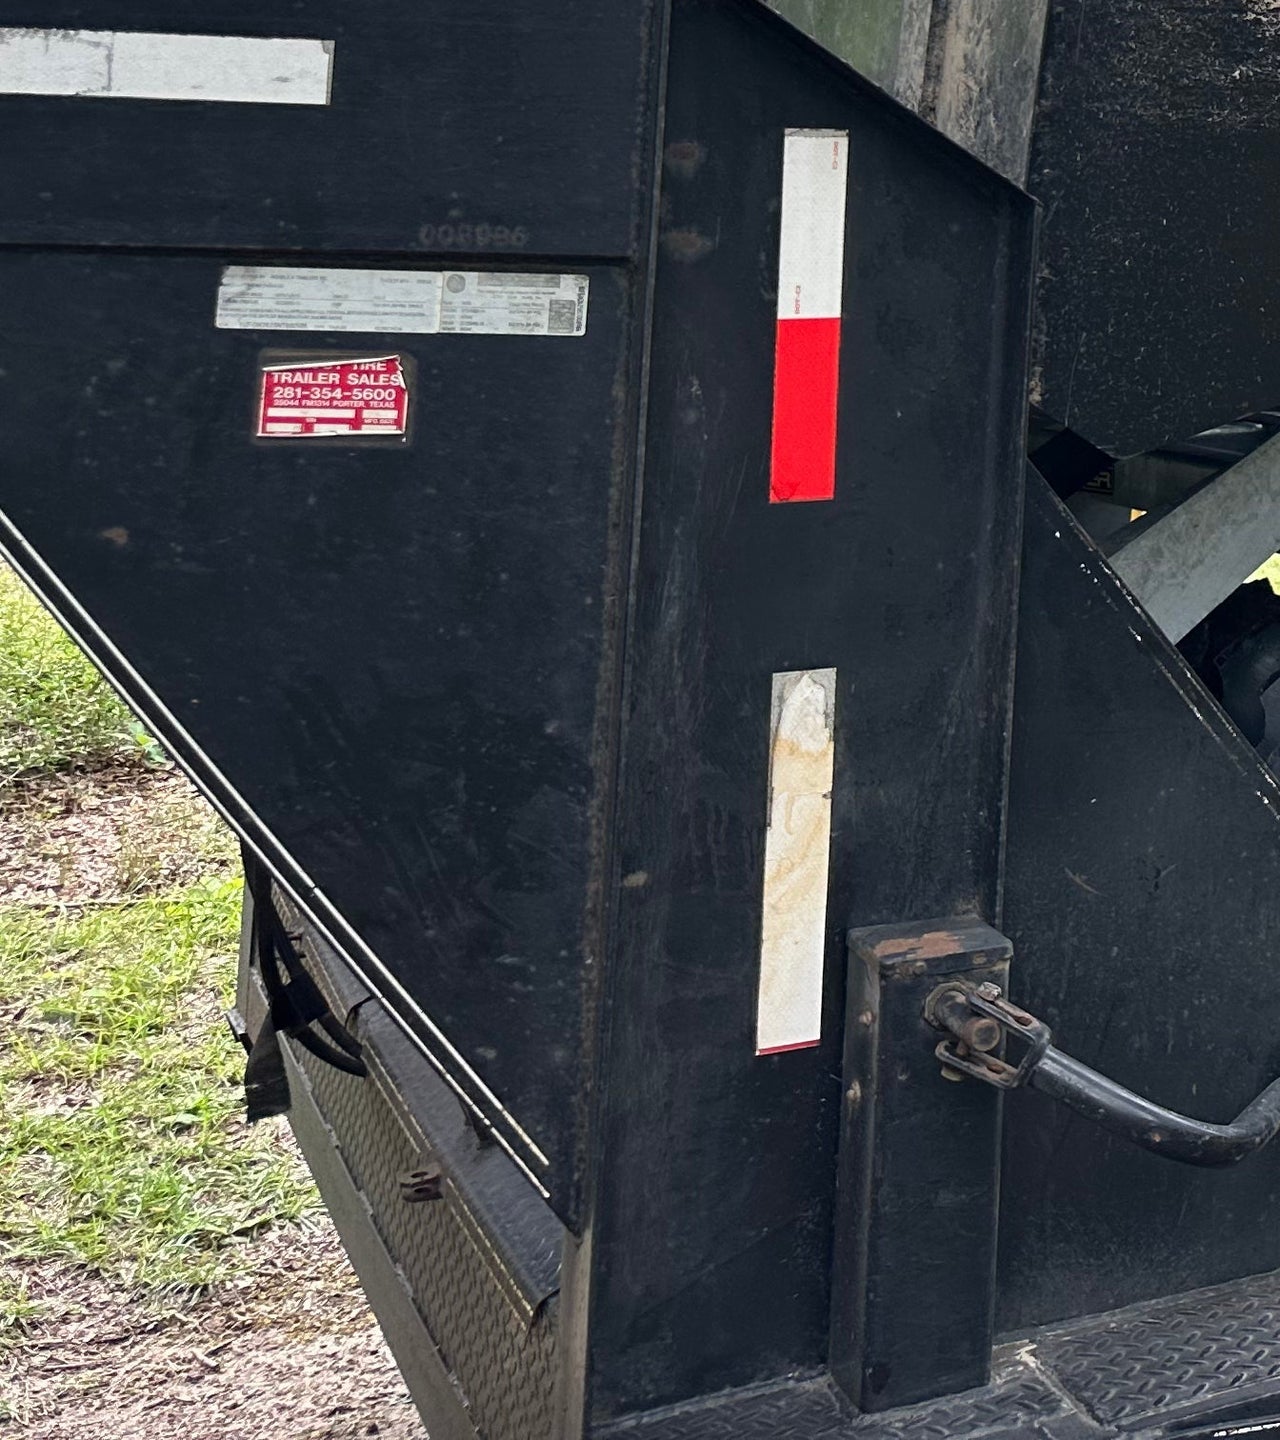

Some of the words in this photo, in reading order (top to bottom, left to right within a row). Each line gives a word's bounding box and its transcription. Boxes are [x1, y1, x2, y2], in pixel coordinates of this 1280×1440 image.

[271, 372, 340, 385] TRAILER
[347, 373, 400, 386] SALES
[273, 386, 397, 401] 281-354-5600
[370, 401, 395, 409] TEXAS
